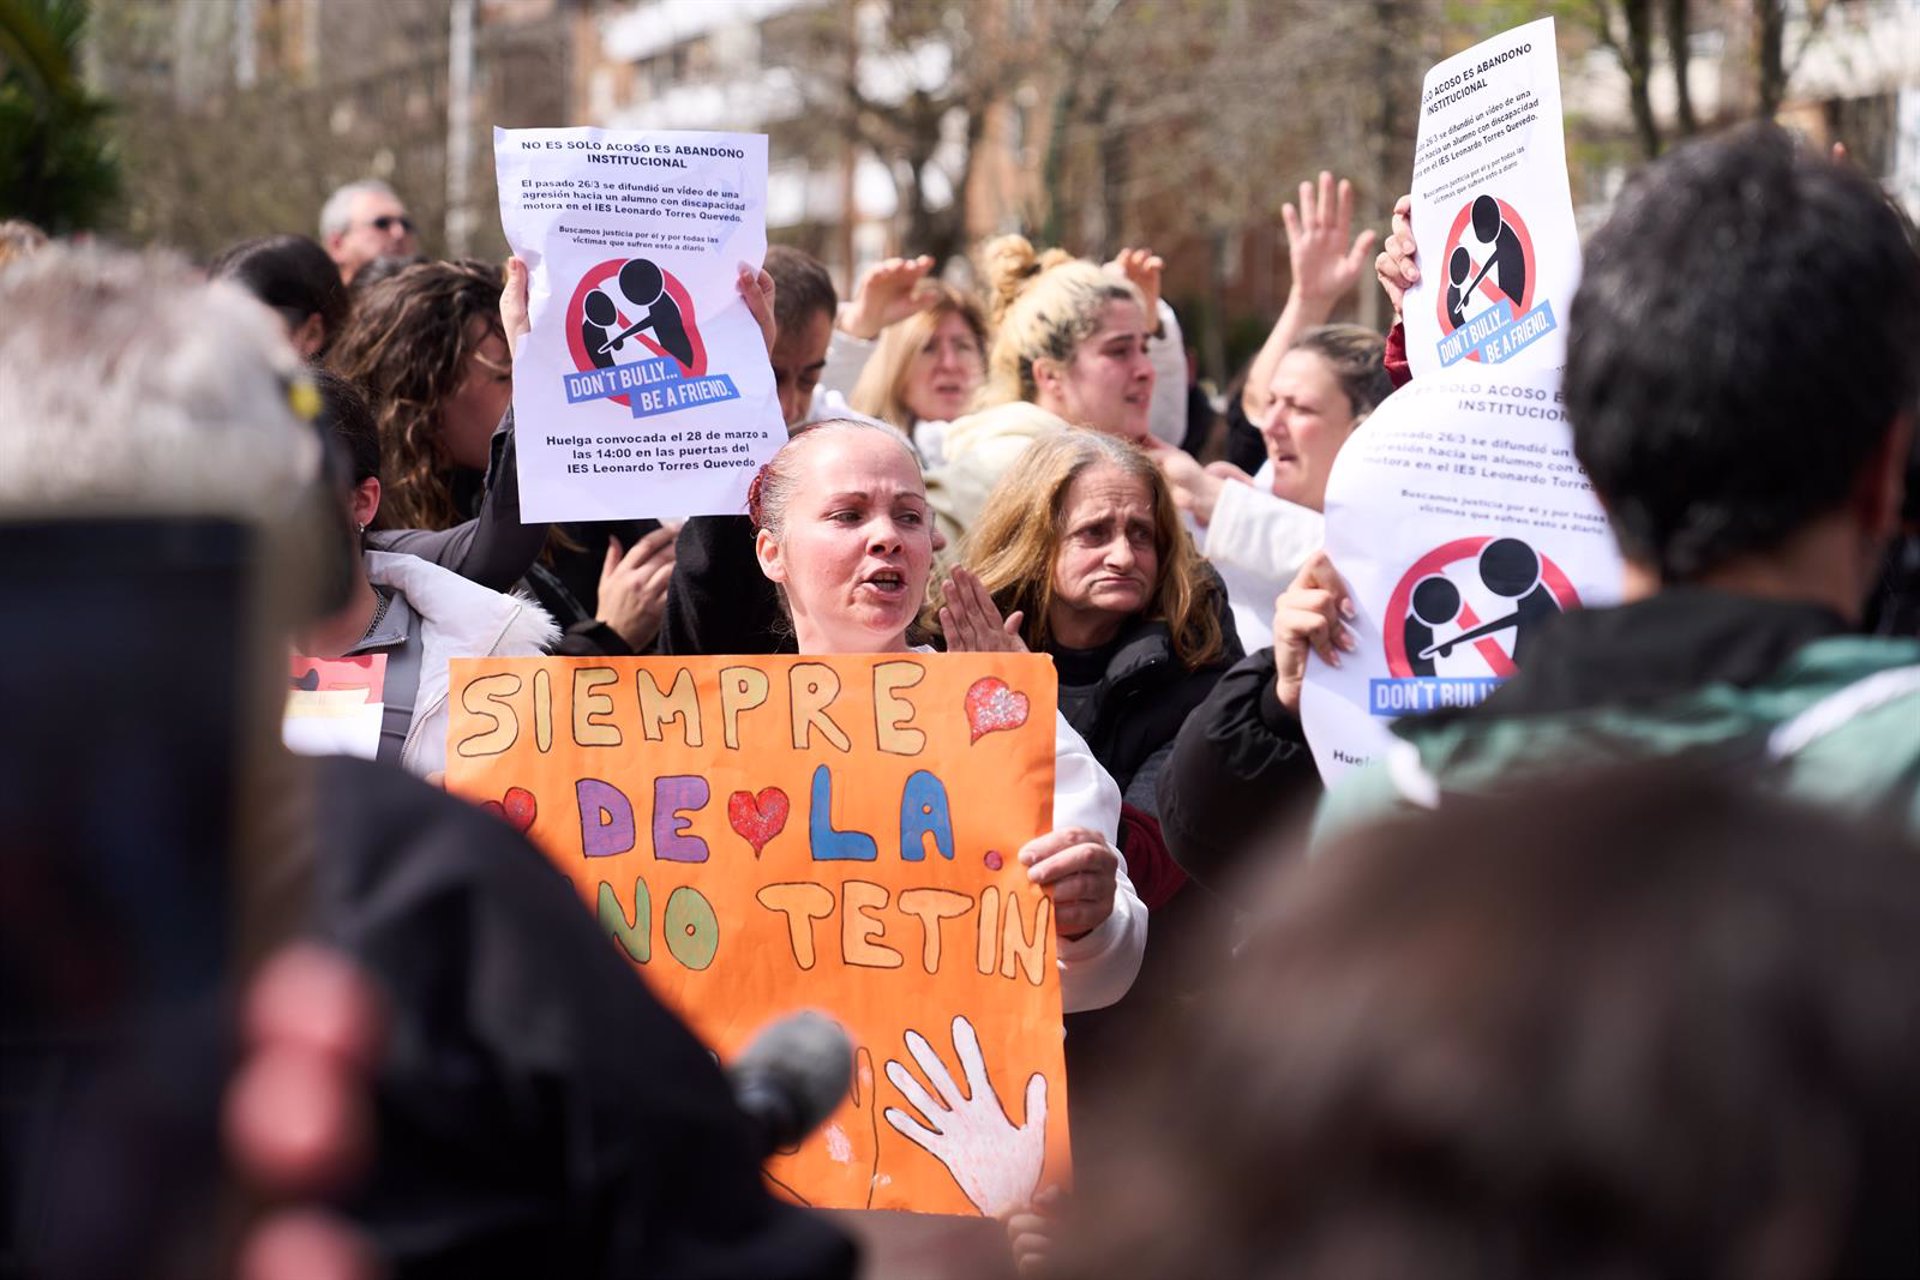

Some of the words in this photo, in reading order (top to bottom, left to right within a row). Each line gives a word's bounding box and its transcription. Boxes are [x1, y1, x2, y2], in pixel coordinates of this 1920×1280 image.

[1434, 75, 1462, 96] ACOSO
[1463, 68, 1475, 81] ES
[1477, 43, 1532, 74] ABANDONO
[1427, 78, 1488, 116] INSTITUCIONAL
[522, 141, 541, 150] NO
[546, 141, 562, 150] ES
[567, 141, 602, 151] SOLO
[606, 143, 650, 153] ACOSO
[655, 145, 671, 154] ES
[675, 146, 744, 159] ABANDONO
[587, 154, 688, 169] INSTITUCIONAL
[522, 190, 570, 200] agresión
[573, 191, 602, 200] hacia
[621, 194, 658, 204] alumno
[661, 198, 679, 206] con
[681, 199, 746, 211] discapacidad
[535, 180, 574, 189] pasado
[618, 183, 659, 192] difundió
[662, 186, 674, 194] un
[677, 185, 704, 196] vídeo
[706, 189, 719, 198] de
[721, 191, 739, 199] una
[523, 202, 563, 210] motora
[582, 203, 592, 211] el
[595, 204, 612, 212] IES
[615, 205, 662, 216] Leonardo
[665, 208, 697, 219] Torres
[699, 211, 743, 222] Quevedo.
[559, 225, 600, 235] Buscamos
[602, 229, 633, 237] justicia
[635, 232, 649, 240] por
[667, 234, 681, 242] por
[683, 235, 705, 243] todas
[572, 236, 607, 245] víctimas
[627, 241, 653, 249] sufren
[655, 242, 673, 250] esto
[682, 244, 705, 252] diario
[1440, 329, 1469, 363] DON'T
[1485, 341, 1501, 364] BE
[1502, 335, 1511, 355] A
[1511, 310, 1550, 350] FRIEND.
[570, 370, 616, 398] DON'T
[621, 361, 678, 388] BULLY...
[640, 390, 664, 411] BE
[666, 388, 678, 407] A
[681, 379, 732, 405] FRIEND.
[1488, 384, 1547, 402] ACOSO
[1458, 399, 1566, 422] INSTITUCIO
[546, 435, 592, 447] Huelga
[596, 433, 667, 445] convocada
[671, 432, 682, 442] el
[686, 431, 702, 442] 28
[706, 430, 721, 441] de
[724, 431, 759, 440] marzo
[1471, 437, 1487, 447] se
[1491, 437, 1547, 454] difundió
[1551, 447, 1570, 457] un
[573, 449, 592, 460] las
[596, 448, 632, 459] 14:00
[635, 449, 652, 458] en
[656, 447, 675, 457] las
[679, 445, 728, 458] puertas
[732, 443, 750, 453] del
[1428, 446, 1467, 460] hacia
[1471, 452, 1488, 462] un
[1492, 454, 1543, 469] alumno
[1547, 461, 1574, 473] con
[567, 464, 589, 474] IES
[593, 462, 654, 474] Leonardo
[658, 461, 699, 472] Torres
[703, 458, 756, 470] Quevedo
[1419, 503, 1466, 517] víctimas
[1470, 511, 1489, 521] que
[1494, 514, 1530, 525] sufren
[1533, 519, 1557, 529] esto
[1570, 523, 1604, 535] diario
[1376, 681, 1435, 710] DON'T
[1441, 683, 1500, 709] BULL
[457, 660, 926, 758] SIEMPRE
[576, 774, 711, 864] DE
[562, 874, 720, 972] NO
